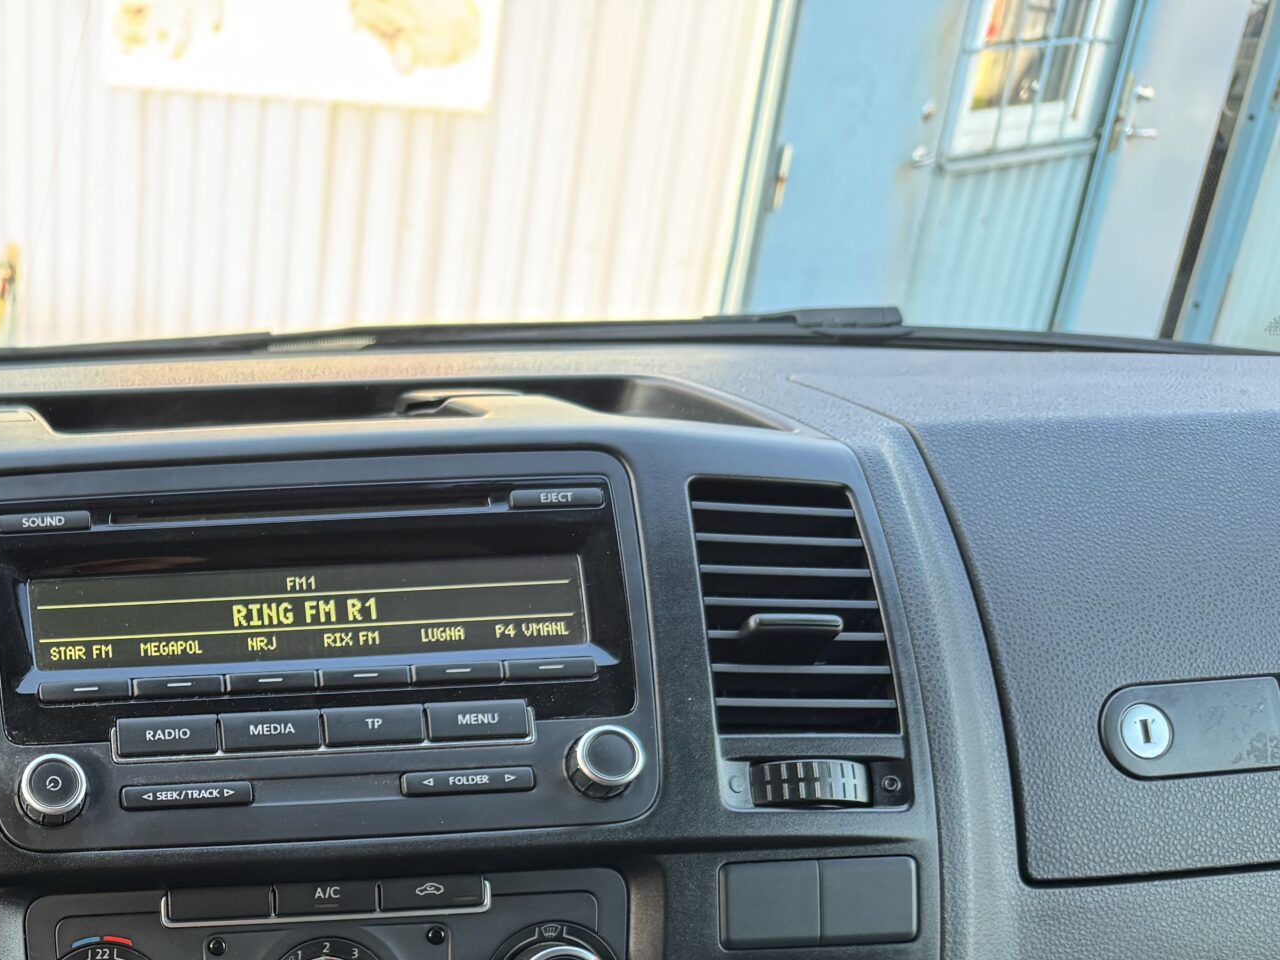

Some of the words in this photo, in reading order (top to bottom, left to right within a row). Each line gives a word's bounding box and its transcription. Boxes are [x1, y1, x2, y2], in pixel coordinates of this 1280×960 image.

[540, 492, 573, 503] EJECT
[22, 516, 65, 528] SOUND
[286, 575, 316, 591] FM1
[232, 603, 294, 627] RING
[304, 599, 337, 624] FM
[347, 597, 378, 621] R1
[420, 626, 465, 643] LUGNA
[495, 623, 516, 639] P4
[522, 621, 570, 637] VMANL
[247, 636, 277, 652] NRJ
[324, 632, 354, 648] RIX
[359, 630, 380, 646] FM
[50, 646, 86, 661] STAR
[92, 644, 113, 659] FM
[140, 640, 203, 657] MEGAPOL
[365, 718, 382, 729] TP
[457, 712, 499, 725] MENU
[145, 728, 191, 742] RADIO
[249, 722, 295, 736] MEDIA
[449, 774, 490, 785] FOLDER
[314, 886, 341, 899] A/C
[95, 948, 110, 960] 22
[322, 942, 330, 953] 2
[351, 948, 359, 959] 3
[296, 950, 303, 960] 1
